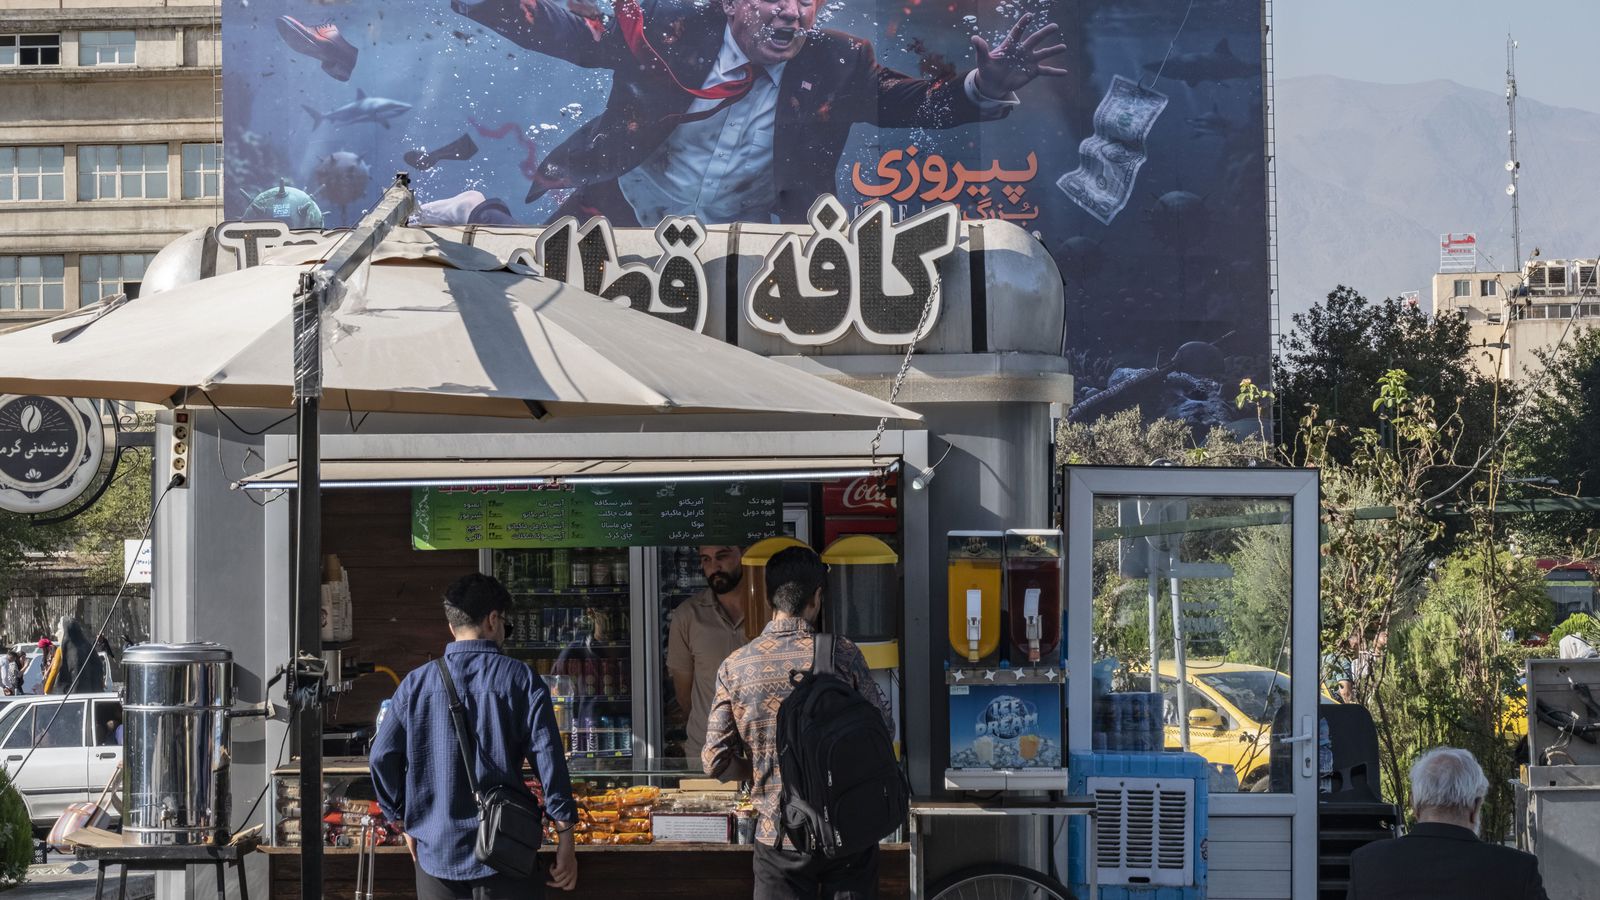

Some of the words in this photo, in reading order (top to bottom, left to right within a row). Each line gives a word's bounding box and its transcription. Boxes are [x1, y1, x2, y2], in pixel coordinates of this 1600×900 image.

[744, 195, 959, 343] کافه
[510, 216, 706, 333] قطا
[24, 441, 69, 459] نوشیدنی
[619, 499, 633, 507] شیر
[678, 497, 705, 507] آمریکانو
[760, 498, 775, 506] قهوه
[742, 508, 760, 517] دوبل
[761, 509, 775, 517] قهوه
[691, 521, 705, 529] موکا
[669, 531, 690, 539] نارگیل
[691, 531, 705, 539] شیر
[991, 700, 1022, 715] ICE
[975, 713, 1039, 736] DREAM
